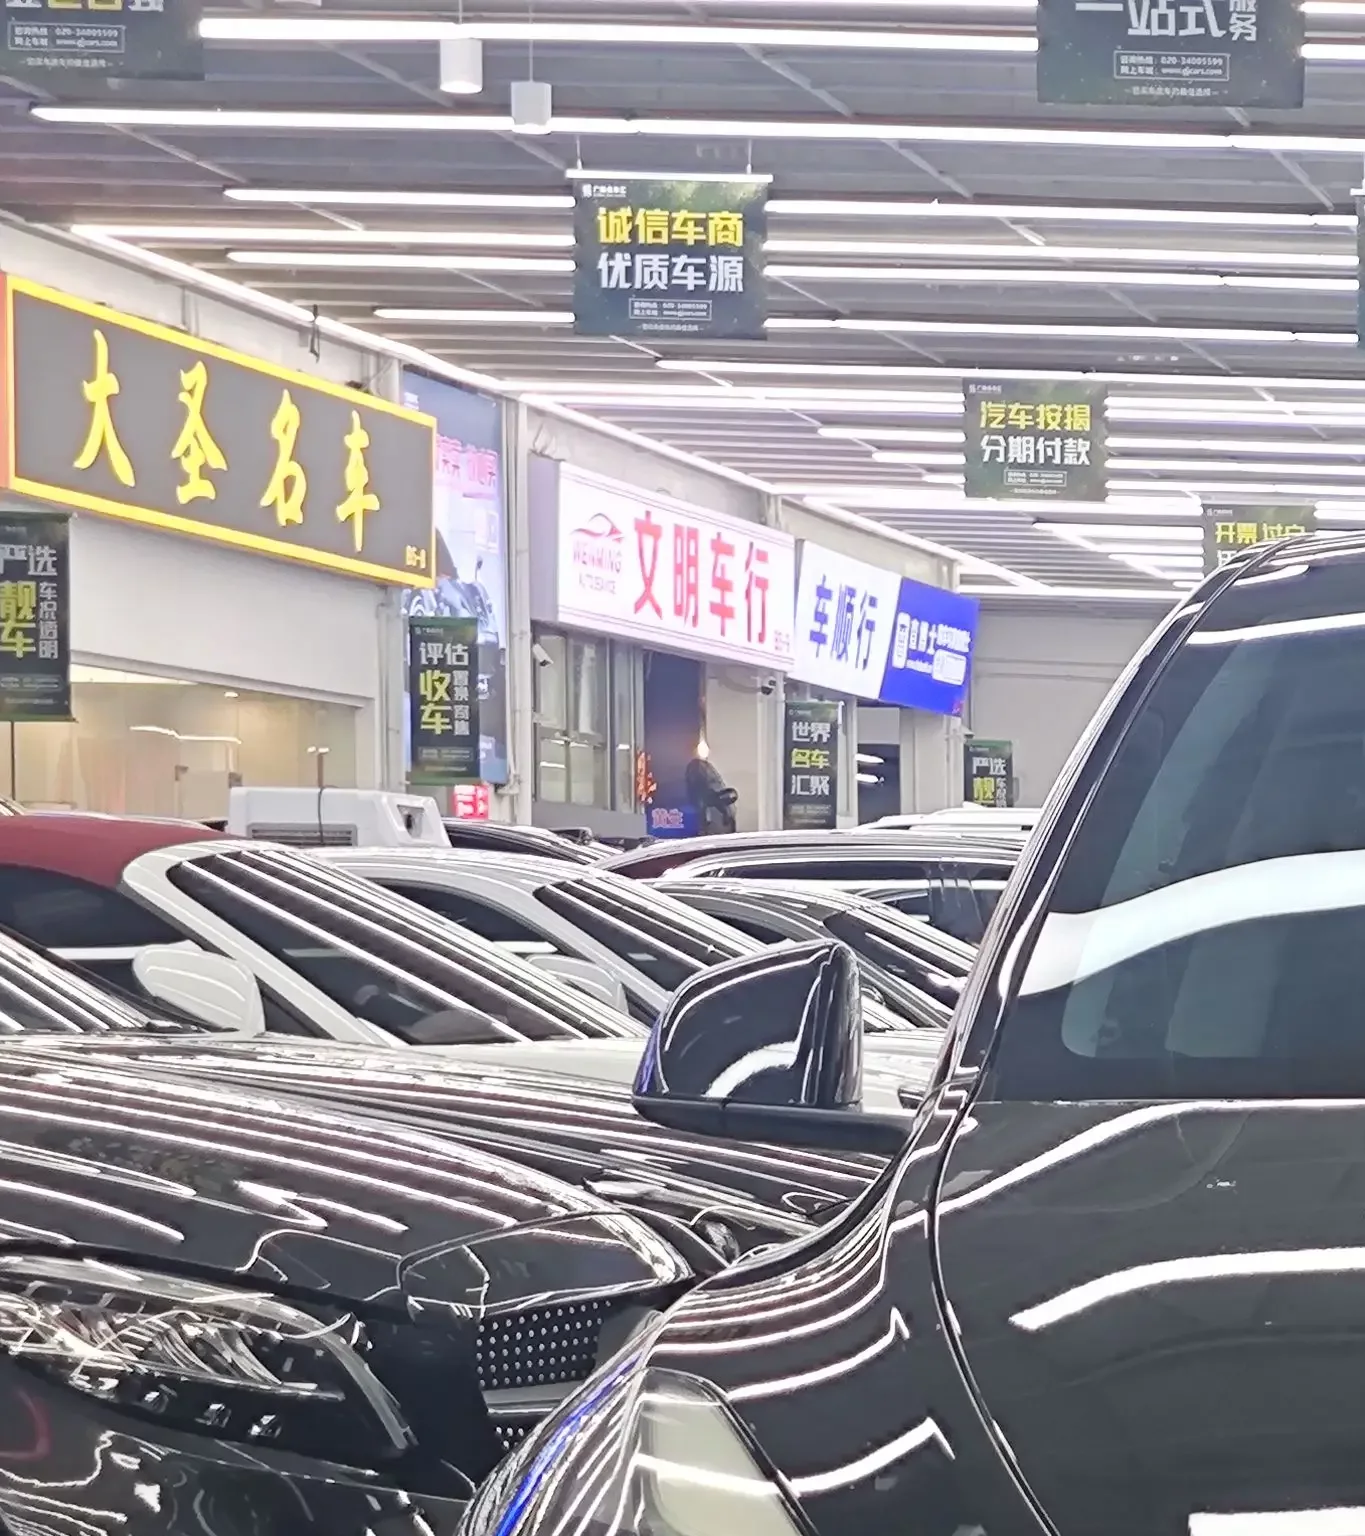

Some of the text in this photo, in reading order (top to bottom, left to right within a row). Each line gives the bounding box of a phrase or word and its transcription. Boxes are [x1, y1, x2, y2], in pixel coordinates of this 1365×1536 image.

[597, 206, 744, 247] 诚信车商
[597, 252, 745, 292] 优质车源
[979, 401, 1092, 432] 汽车按揭
[73, 329, 381, 553] 大圣名车
[980, 434, 1091, 466] 分期付款
[0, 544, 58, 576] 严选
[633, 510, 770, 644] 文明车行
[808, 574, 879, 671] 车顺行
[419, 642, 469, 666] 评估
[419, 669, 453, 735] 收车
[792, 721, 831, 743] 世界
[791, 748, 830, 769] 名车
[791, 774, 830, 796] 汇聚
